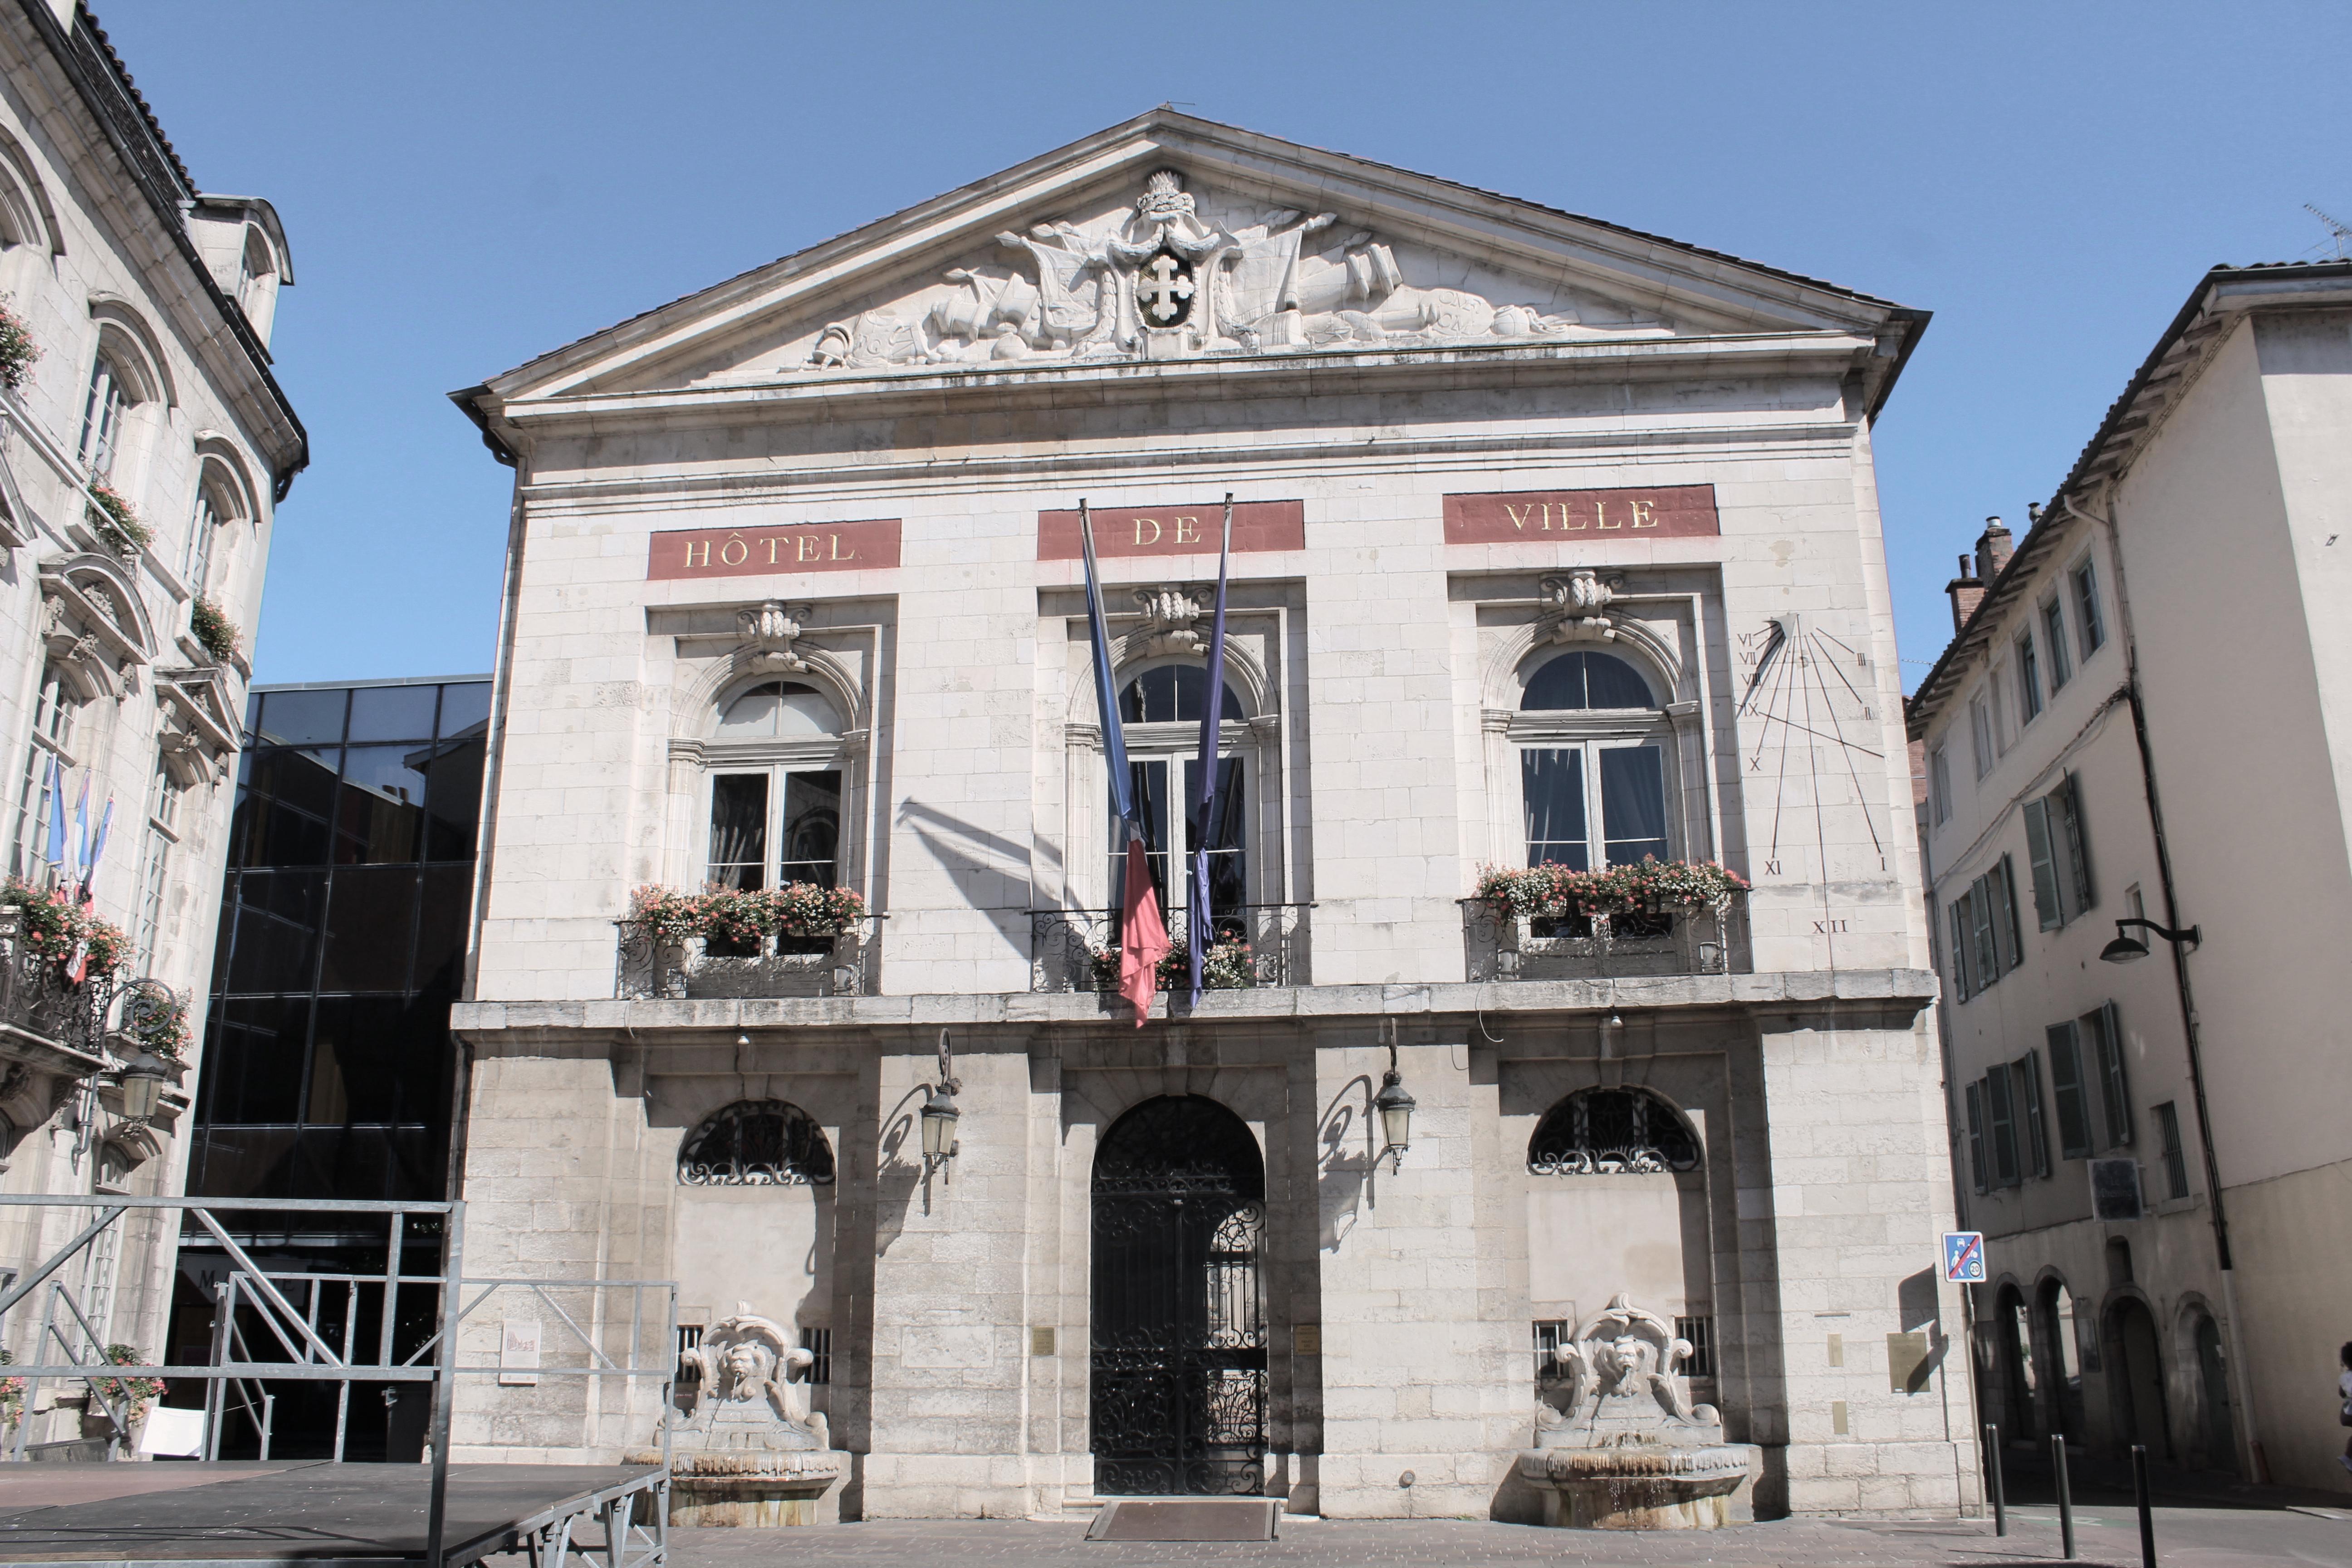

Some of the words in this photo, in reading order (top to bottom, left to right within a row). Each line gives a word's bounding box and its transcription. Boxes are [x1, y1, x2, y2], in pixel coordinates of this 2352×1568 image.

[683, 531, 856, 568] HÔTEL
[1132, 516, 1200, 546] DE
[1504, 500, 1658, 531] VILLE
[1737, 633, 1752, 646] VI
[1739, 652, 1757, 665] VII
[1857, 652, 1866, 666] III
[1741, 673, 1761, 686] VIII
[1744, 703, 1759, 716] IX
[1865, 707, 1872, 720] II
[1749, 757, 1761, 771] X
[1764, 860, 1782, 875] XI
[1881, 857, 1886, 871] I
